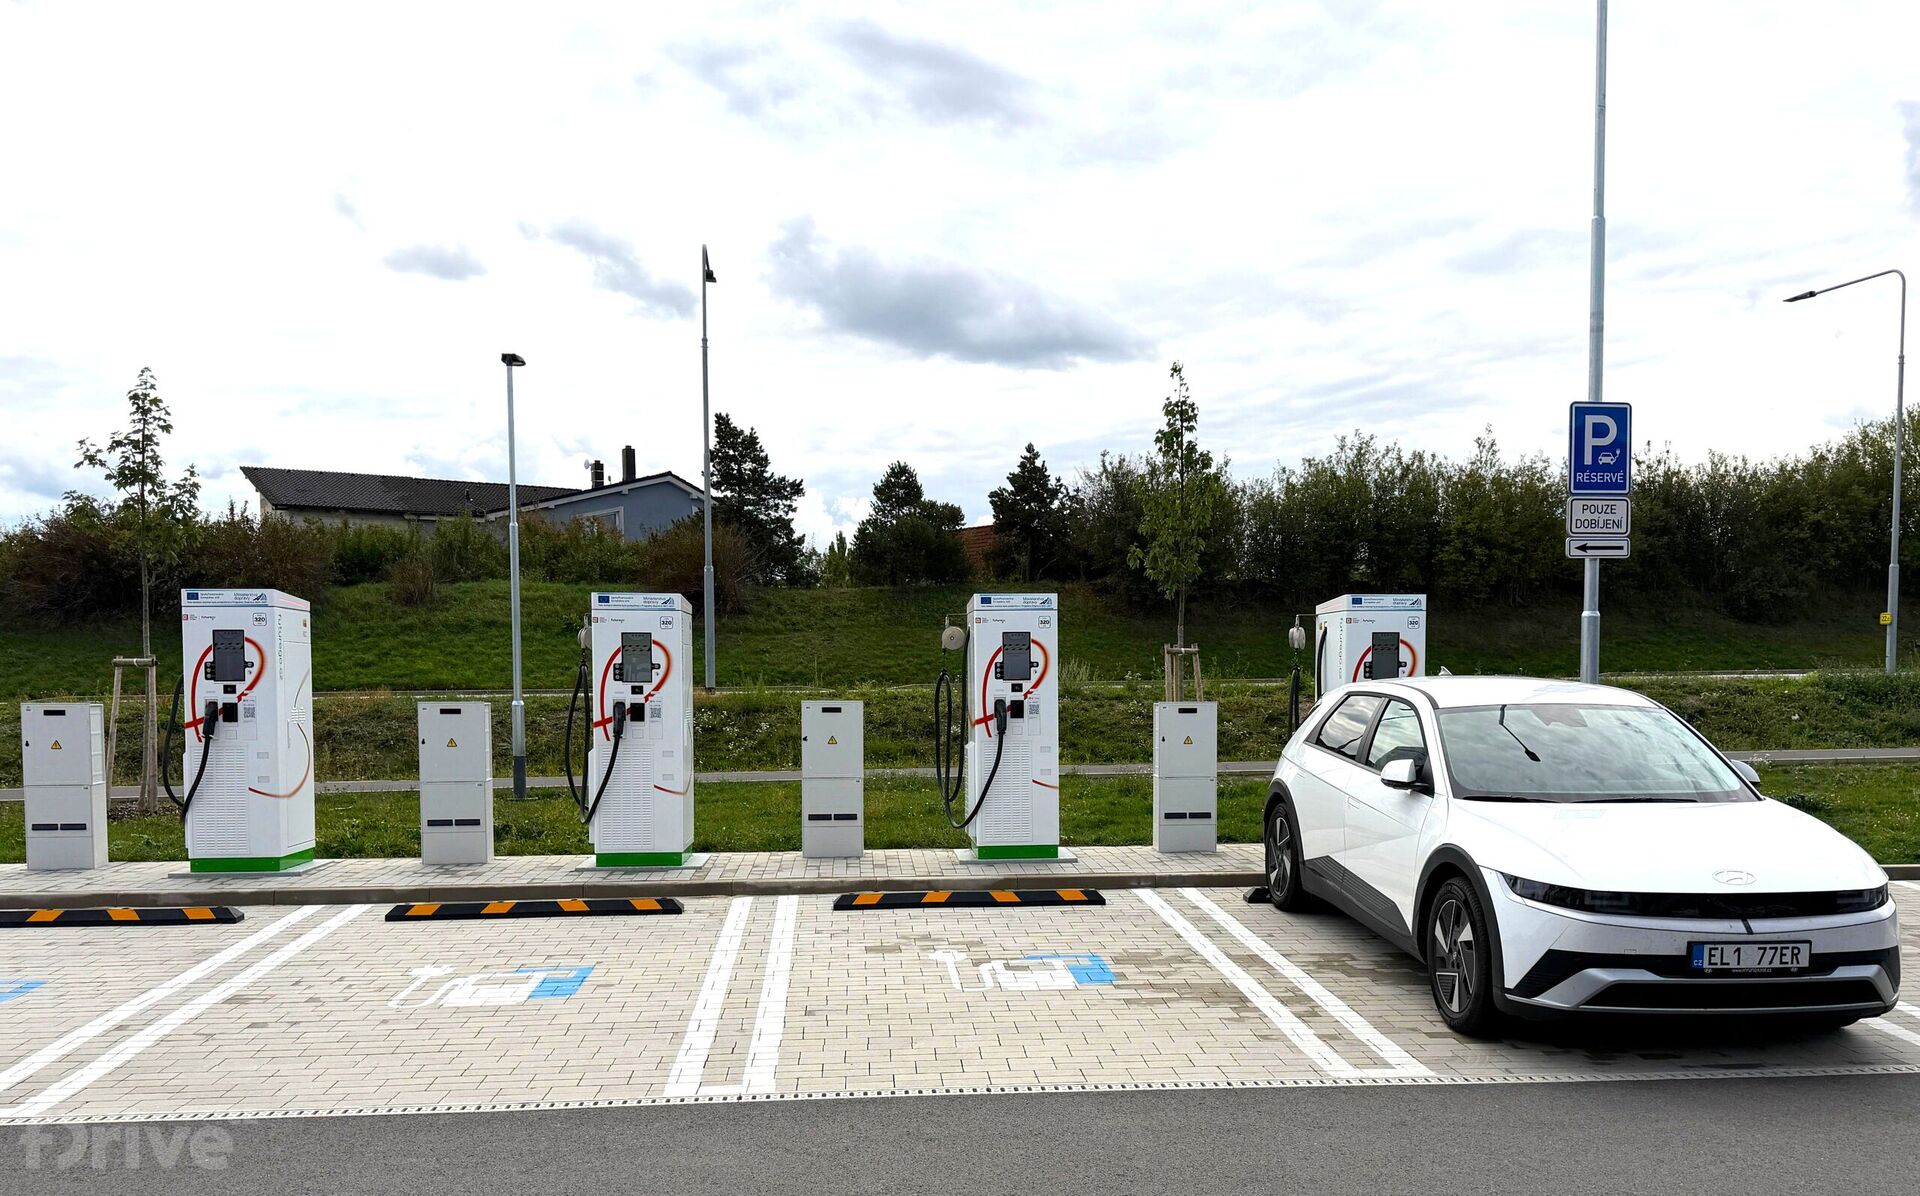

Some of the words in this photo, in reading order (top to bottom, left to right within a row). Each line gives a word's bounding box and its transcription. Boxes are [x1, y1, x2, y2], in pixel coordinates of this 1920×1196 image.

[1584, 415, 1617, 465] P
[1576, 470, 1624, 482] RÉSERVÉ
[1582, 504, 1617, 514] POUZE
[1575, 516, 1623, 529] DOBÍJENÍ
[1708, 947, 1741, 966] EL1
[1757, 946, 1800, 966] 77ER
